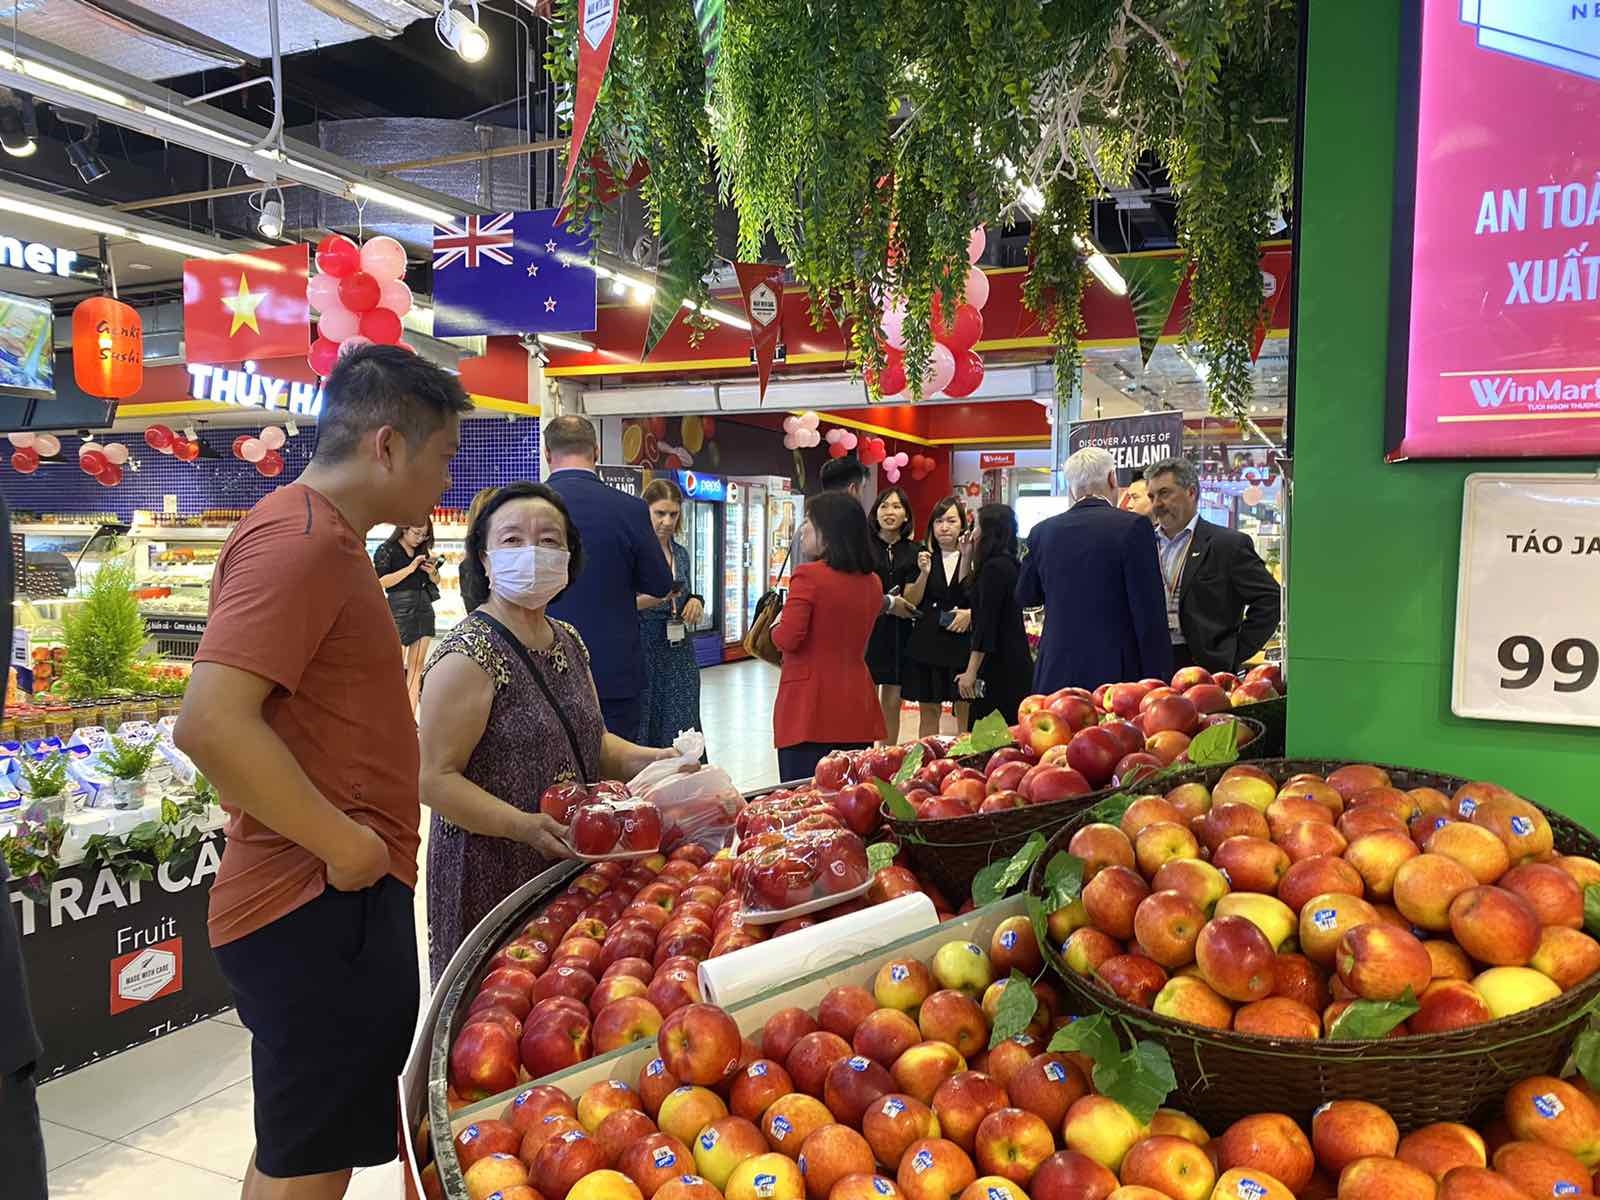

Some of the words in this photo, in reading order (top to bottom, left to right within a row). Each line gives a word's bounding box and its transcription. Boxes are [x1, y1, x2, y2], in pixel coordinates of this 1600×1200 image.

[1475, 187, 1528, 235] AN
[187, 360, 287, 411] THỦY
[1469, 376, 1600, 407] WinMart
[1079, 436, 1120, 448] DISCOVER
[1121, 437, 1128, 445] A
[1130, 433, 1156, 444] TASTE
[1158, 432, 1171, 442] OF
[1506, 529, 1563, 554] TÁO
[1497, 635, 1599, 693] 99
[117, 916, 177, 955] Fruit
[142, 968, 155, 979] WITH
[156, 963, 169, 975] CARE
